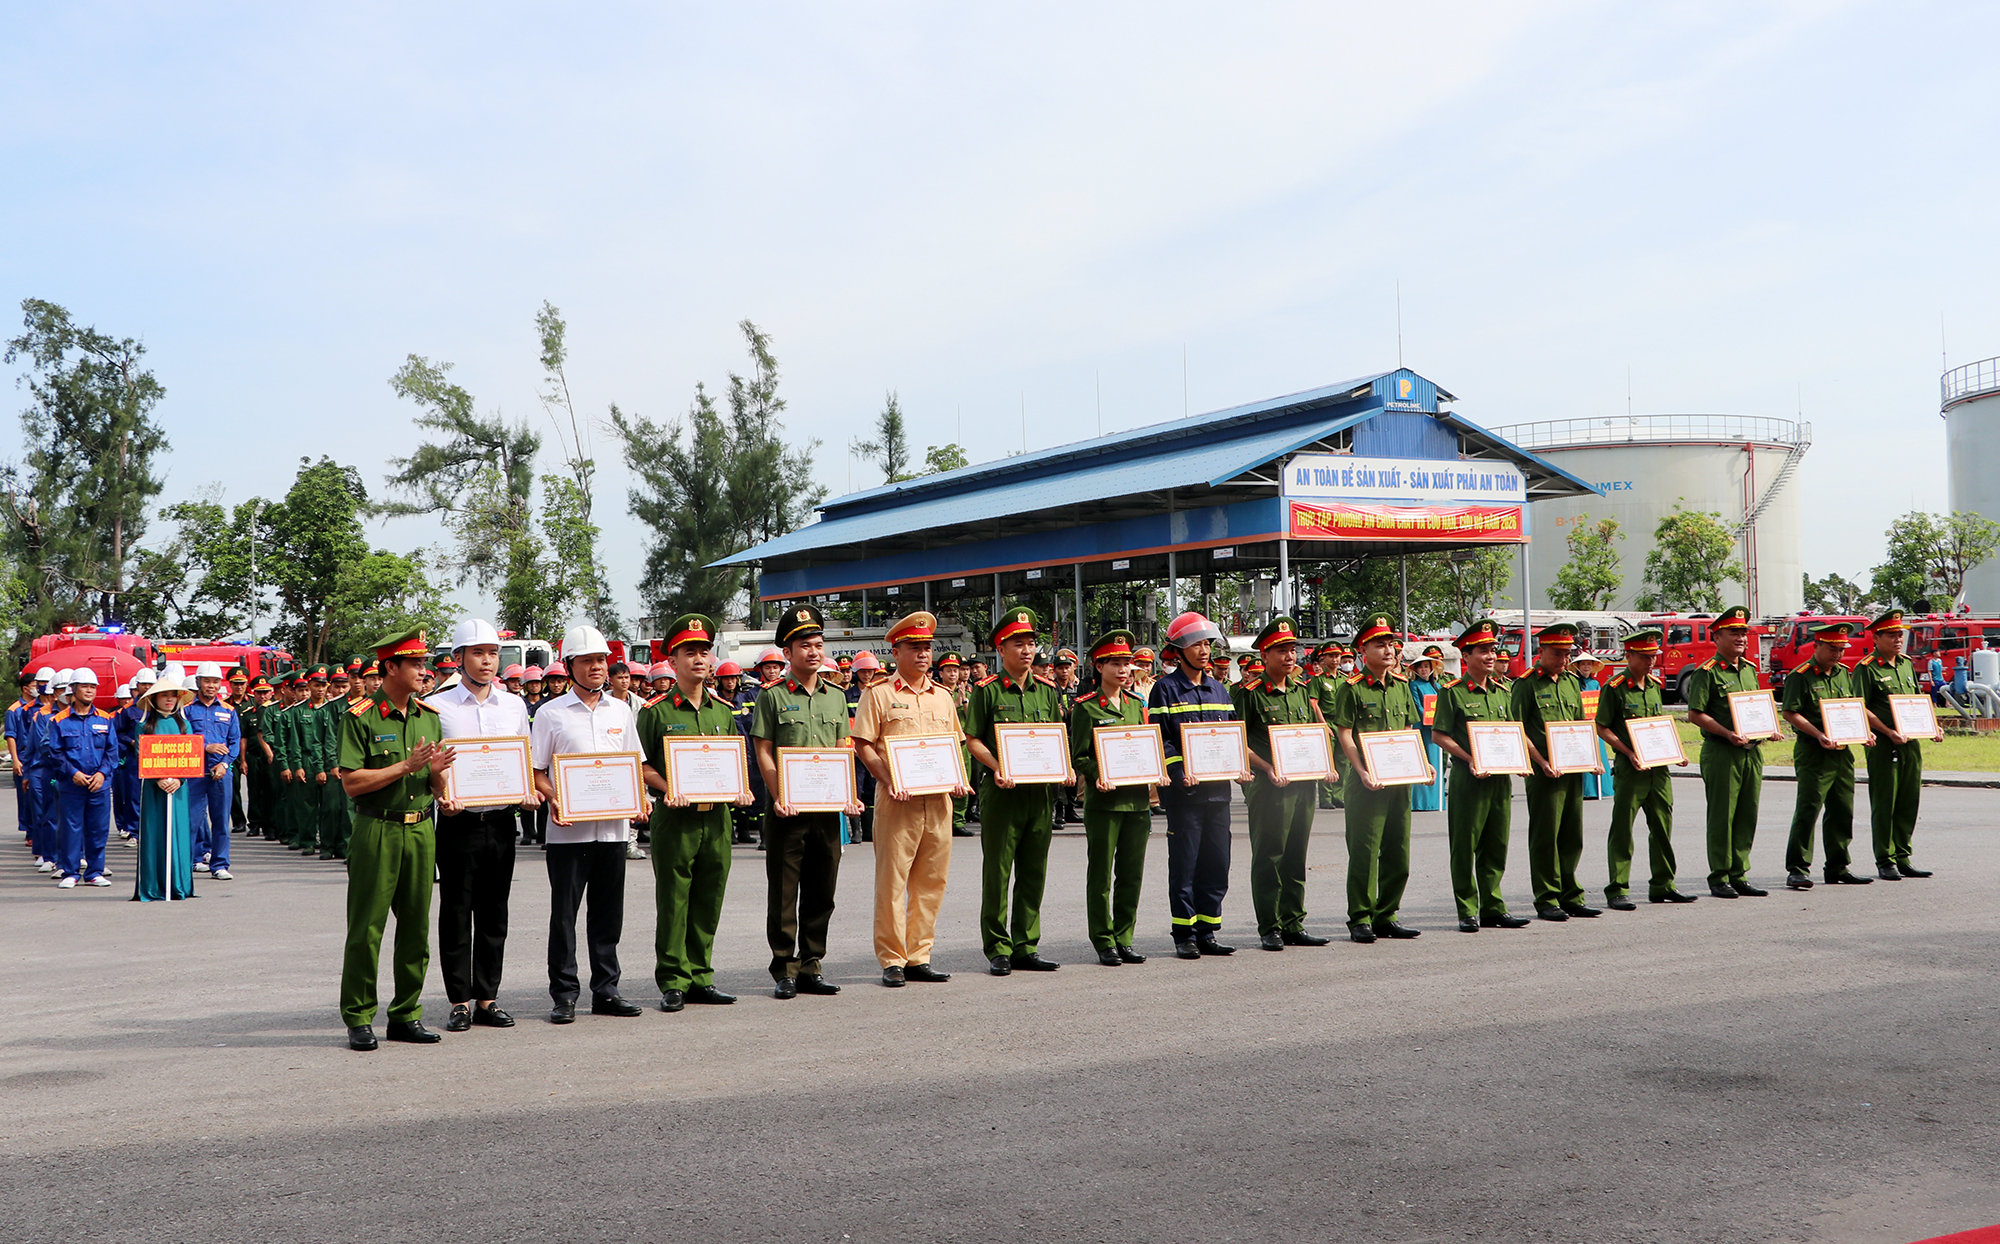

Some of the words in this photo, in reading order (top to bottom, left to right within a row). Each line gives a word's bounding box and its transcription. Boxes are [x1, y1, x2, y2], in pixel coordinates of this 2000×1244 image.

[1296, 468, 1310, 486] AN
[1314, 465, 1339, 486] TOÀN
[1341, 462, 1354, 487] ĐỂ
[1356, 464, 1376, 488] SẢN
[1378, 465, 1401, 488] XUẤT
[1410, 467, 1429, 489] SẢN
[1432, 467, 1454, 490] XUẤT
[1456, 468, 1477, 490] PHẢI
[1480, 474, 1493, 491] AN
[1495, 471, 1518, 492] TOÀN
[1296, 510, 1316, 530] THỰC
[1317, 510, 1332, 531] TẬP
[1333, 511, 1363, 529] PHƯƠNG
